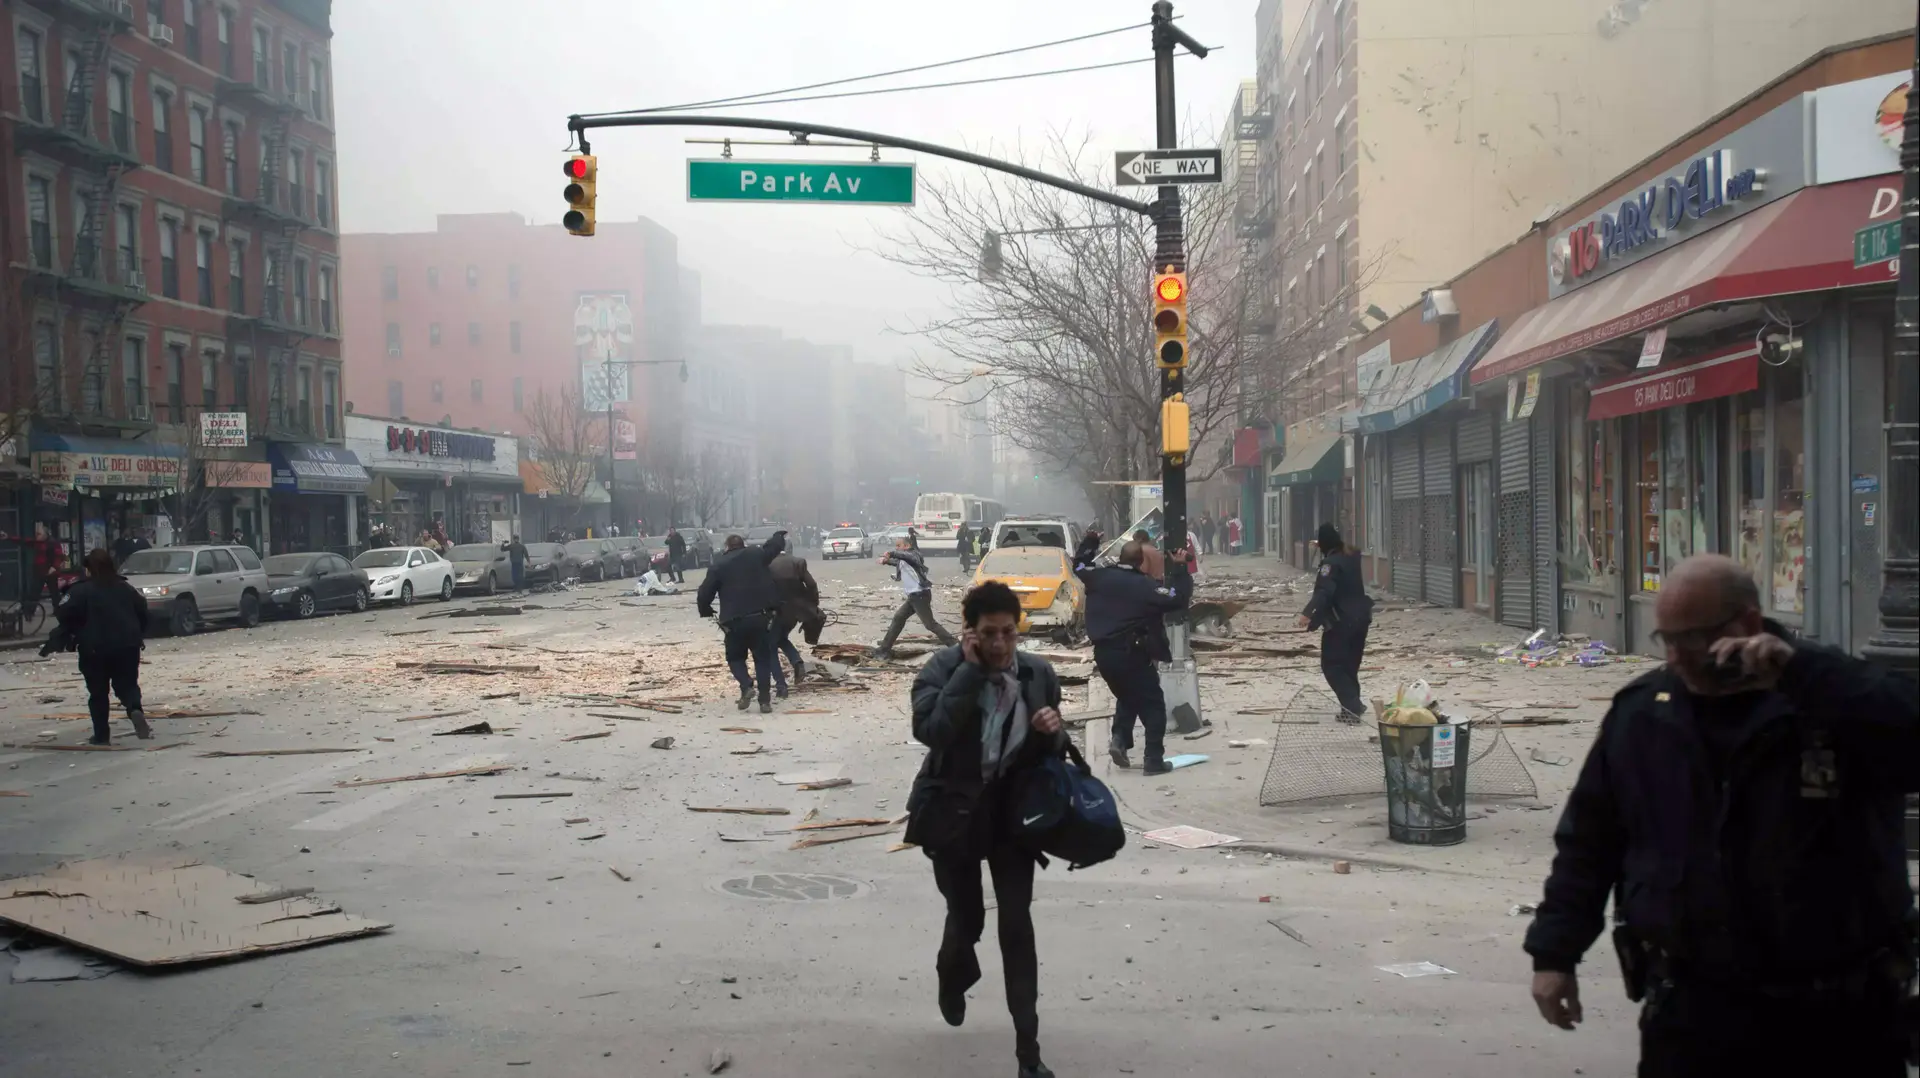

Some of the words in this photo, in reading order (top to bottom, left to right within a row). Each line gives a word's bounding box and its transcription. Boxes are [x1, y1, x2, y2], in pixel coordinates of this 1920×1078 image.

[1132, 161, 1162, 175] ONE
[1176, 159, 1208, 173] WAY
[740, 170, 813, 194] Park
[823, 171, 862, 194] Av
[1569, 220, 1599, 278] 116
[1601, 185, 1658, 260] PARK
[1664, 149, 1724, 231] DELI
[1859, 233, 1867, 262] E
[1871, 228, 1888, 259] 116
[210, 420, 238, 428] DELI
[91, 456, 109, 472] NYC
[111, 458, 132, 472] DELI
[136, 458, 178, 474] GROCERY
